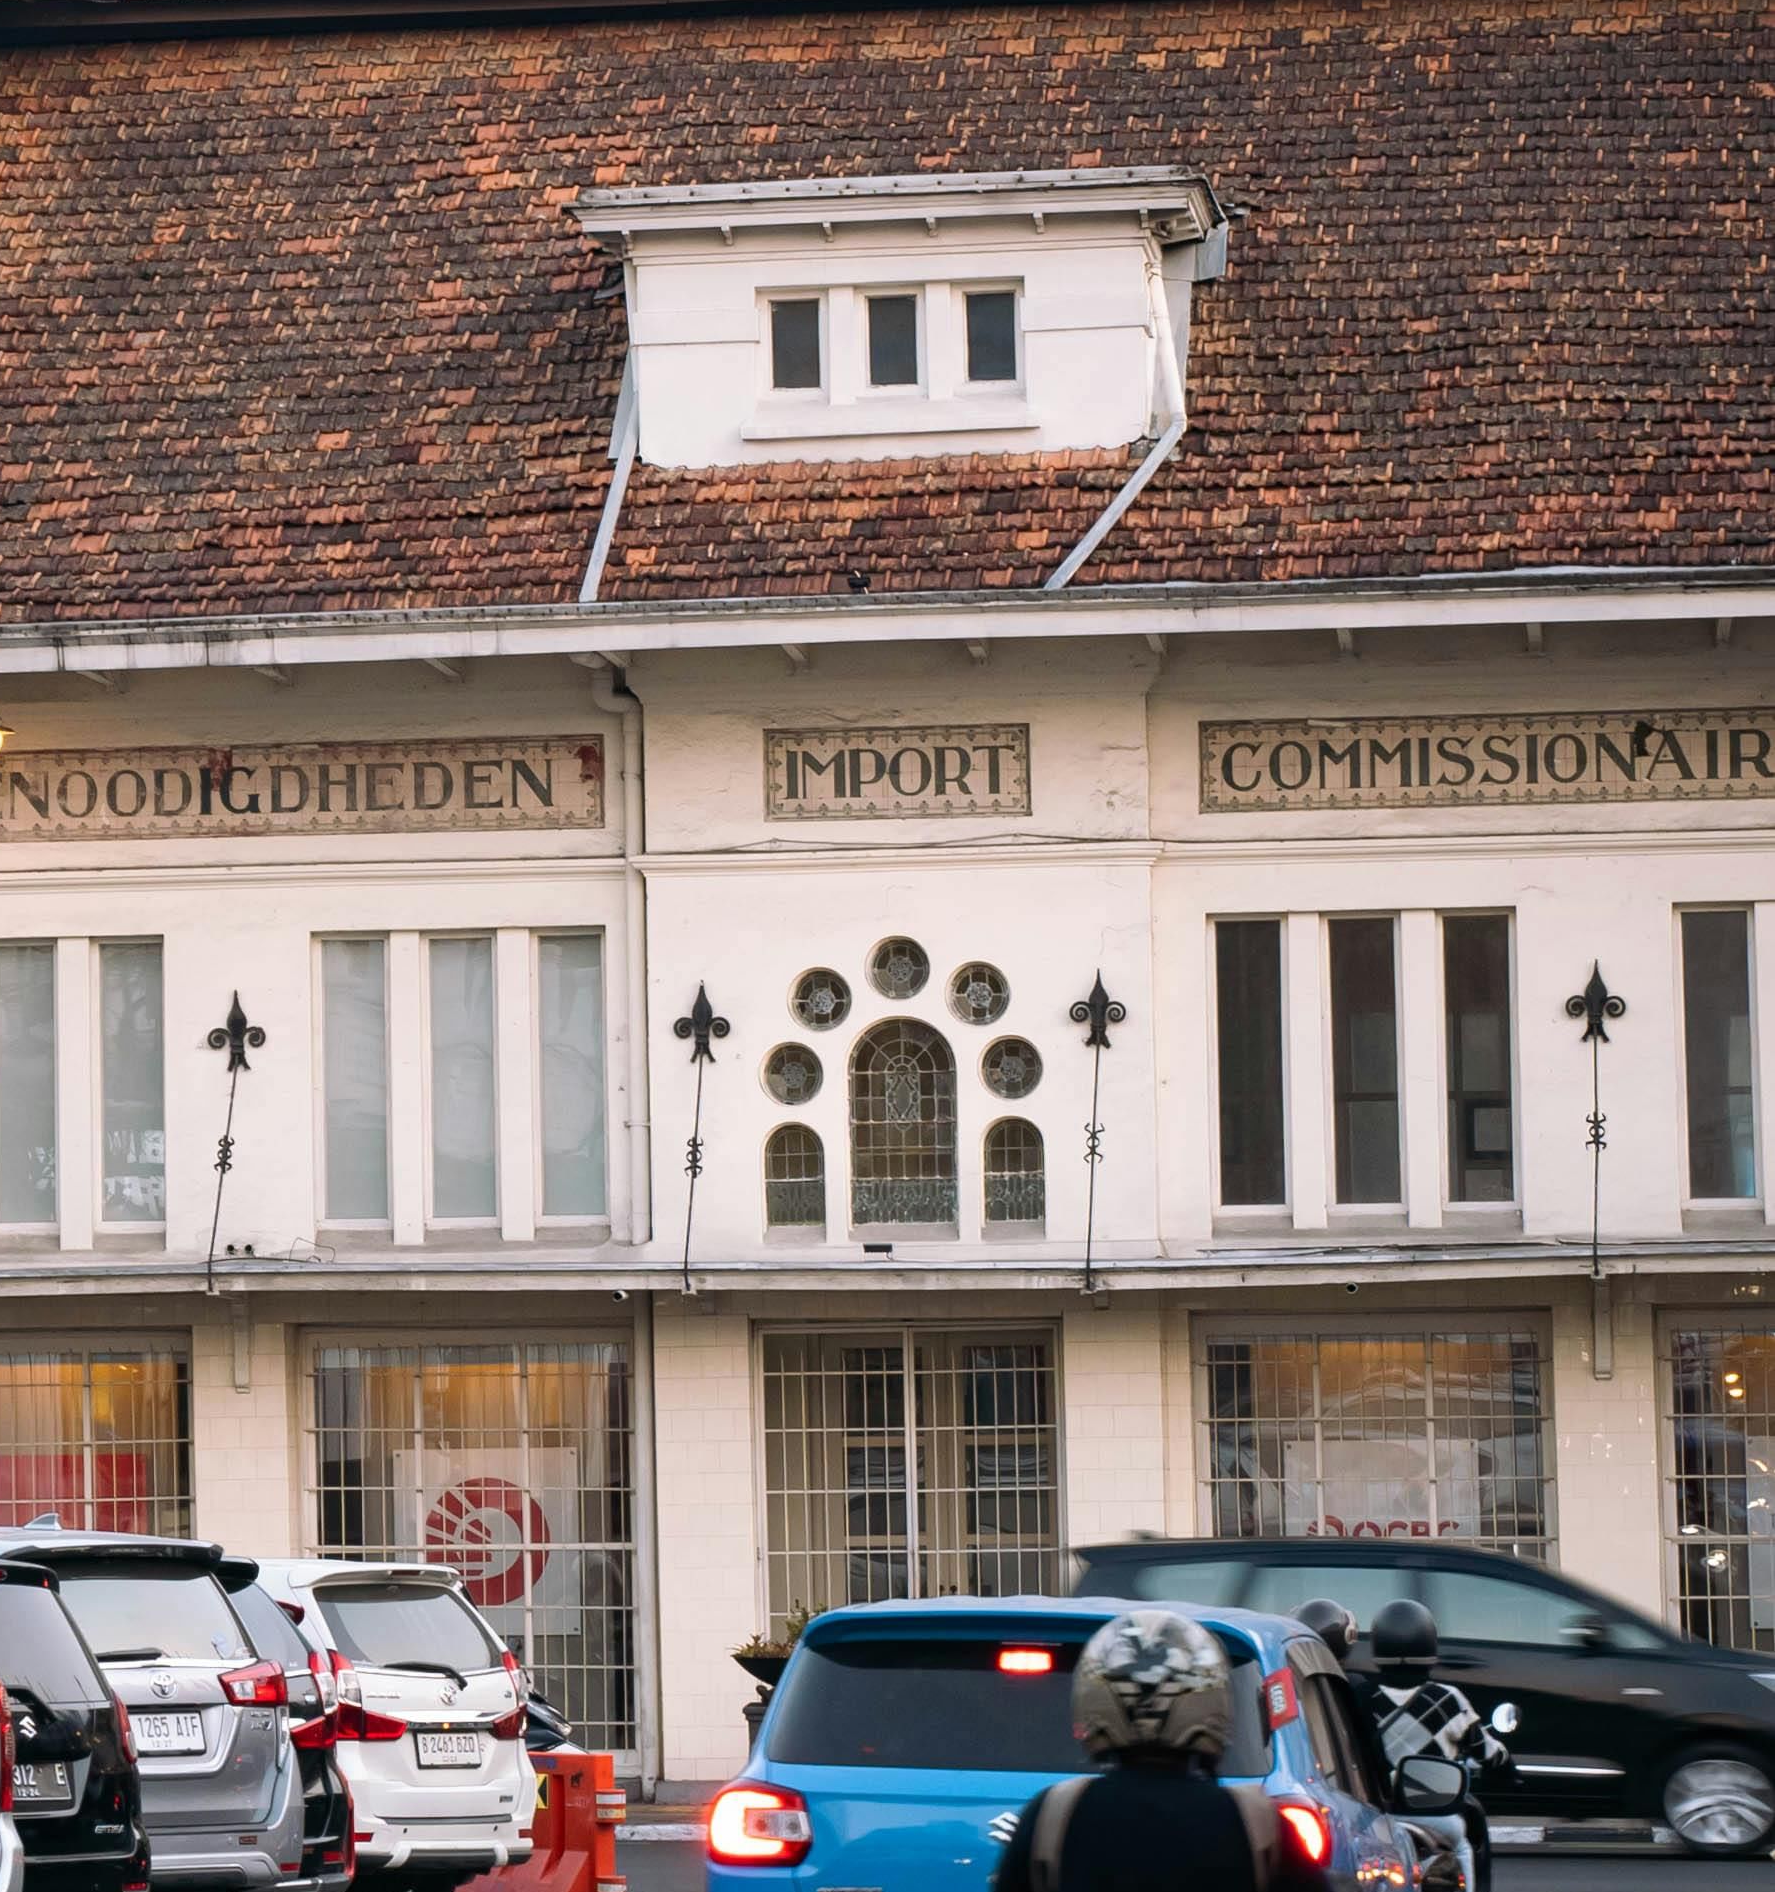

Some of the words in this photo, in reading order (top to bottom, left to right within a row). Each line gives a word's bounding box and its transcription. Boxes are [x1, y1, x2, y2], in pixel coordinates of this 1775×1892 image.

[786, 745, 1016, 800] IMPORT
[1220, 727, 1775, 792] COMMISSIONAIR
[1271, 1684, 1285, 1713] LEGO
[137, 1716, 170, 1739] 1265
[176, 1715, 199, 1738] AIF
[55, 1763, 66, 1786] E
